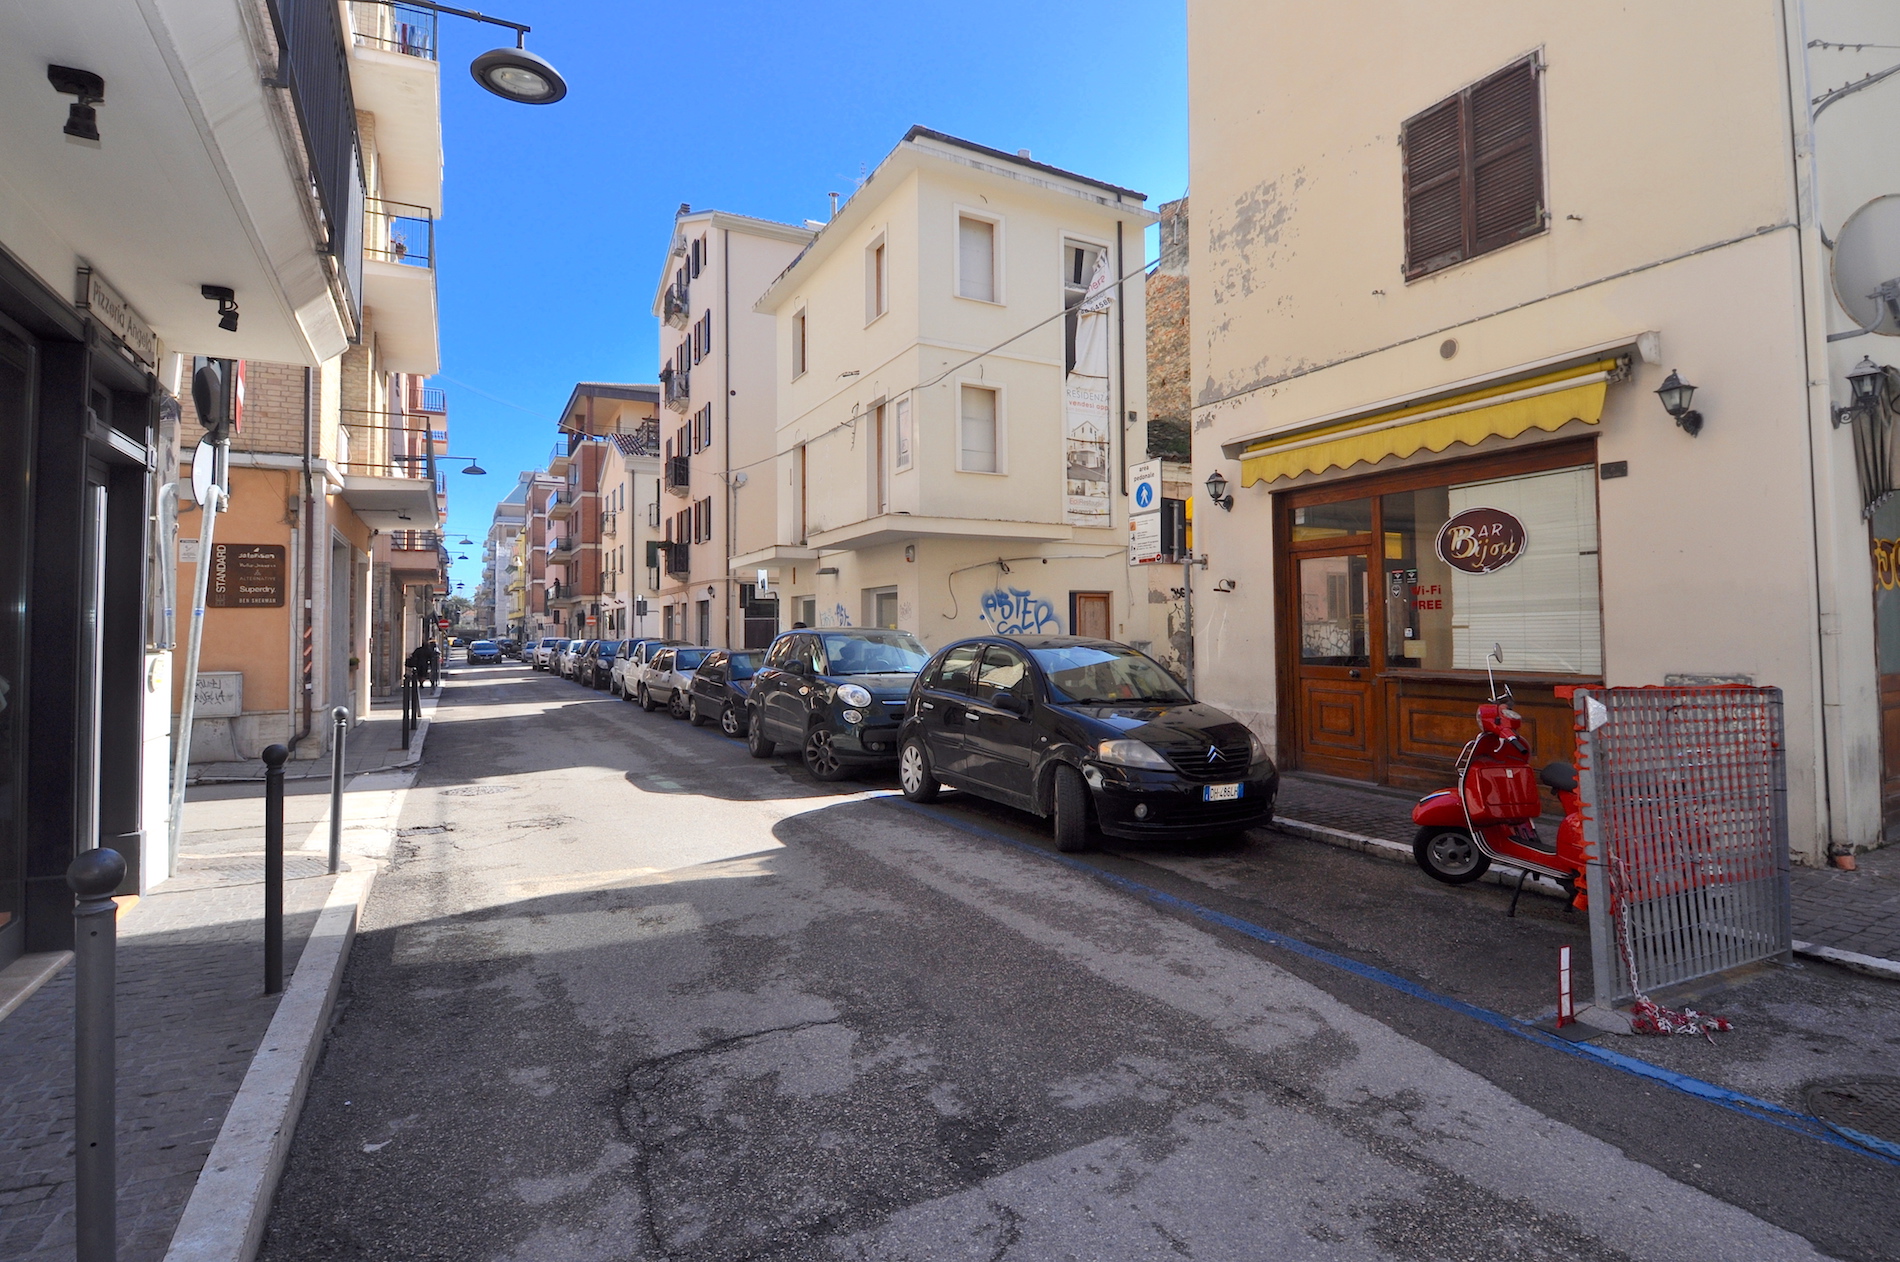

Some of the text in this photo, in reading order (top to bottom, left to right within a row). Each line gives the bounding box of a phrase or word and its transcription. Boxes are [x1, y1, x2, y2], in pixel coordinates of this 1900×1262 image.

[93, 281, 152, 352] Pizzeria Angelo
[1133, 472, 1155, 483] pedonale
[1449, 525, 1516, 568] Bijou
[215, 545, 227, 593] STANDARD
[1410, 585, 1441, 595] Wi-Fi
[1411, 600, 1442, 610] FREE
